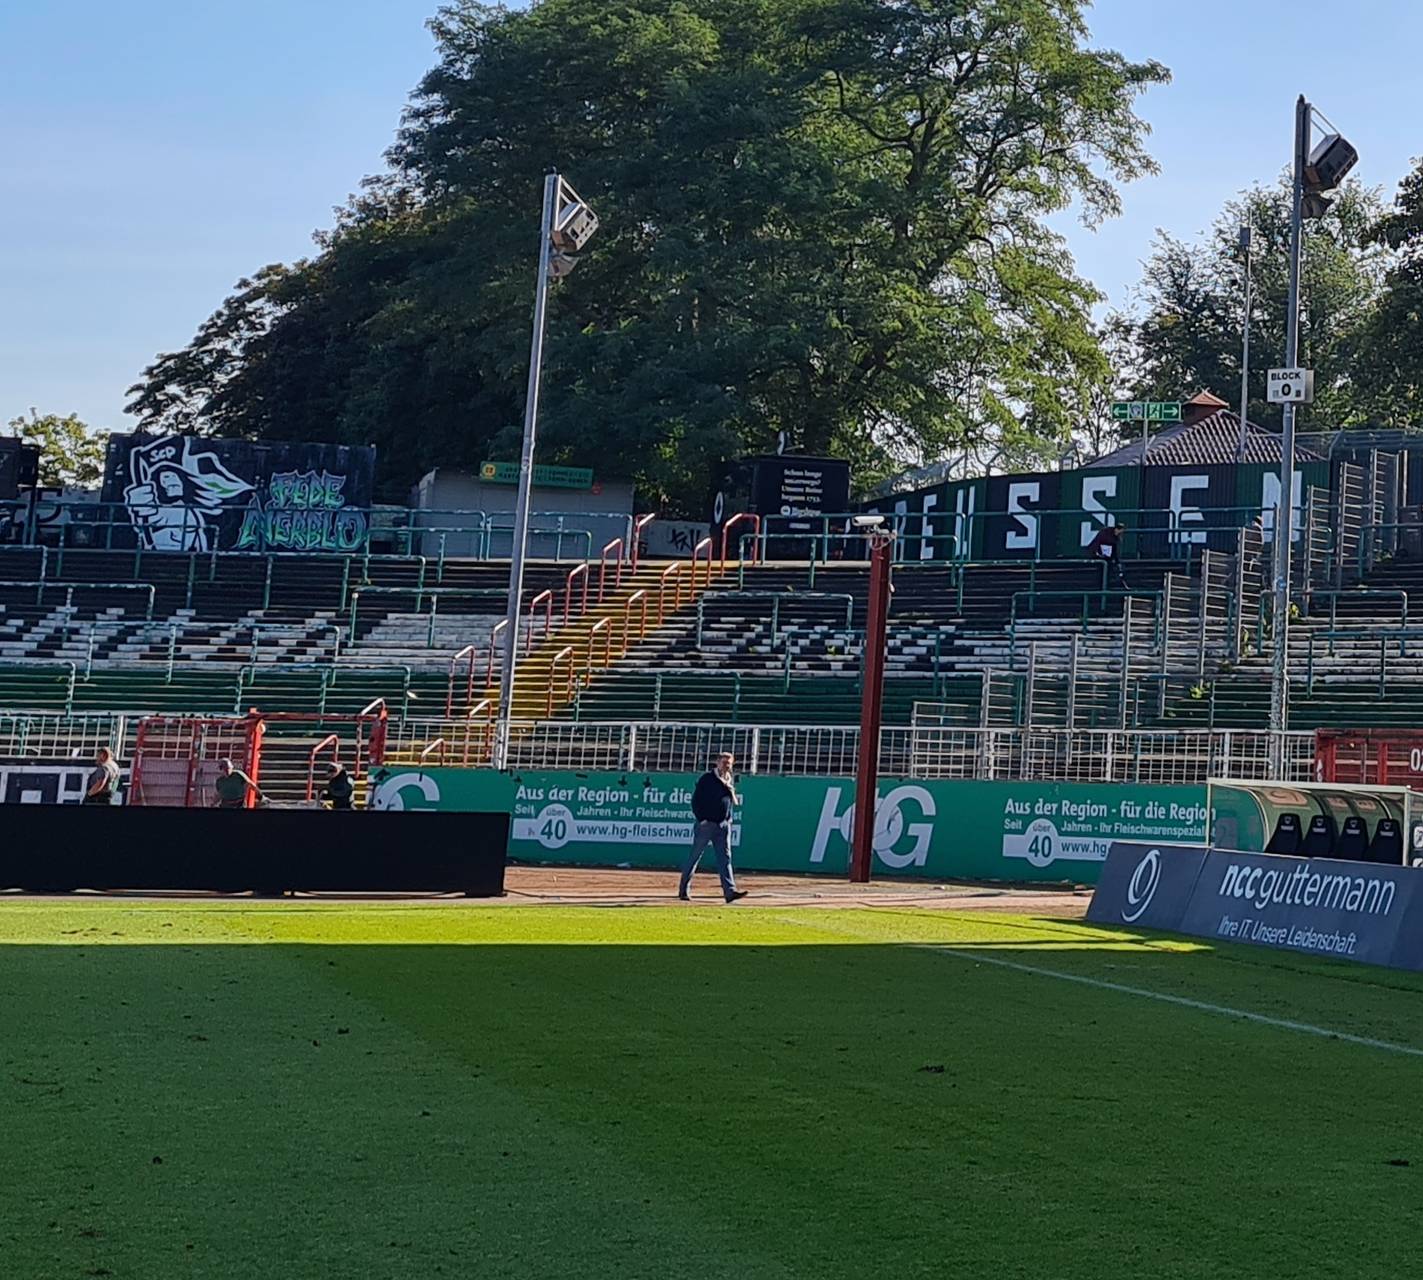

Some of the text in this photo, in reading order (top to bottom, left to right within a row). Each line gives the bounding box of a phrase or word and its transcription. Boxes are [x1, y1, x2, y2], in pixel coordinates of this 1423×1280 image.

[1271, 371, 1302, 381] BLOCK
[150, 446, 176, 461] SCP
[515, 785, 544, 800] Aus
[550, 786, 573, 801] der
[578, 787, 629, 804] Region
[643, 786, 668, 803] für
[669, 788, 692, 804] die
[1004, 799, 1031, 815] Aus
[1035, 799, 1058, 816] der
[1061, 800, 1108, 822] Region
[1120, 801, 1142, 818] für
[1145, 801, 1166, 819] die
[540, 819, 567, 840] 40
[577, 806, 611, 817] Jahren
[620, 807, 634, 818] Ihr
[1004, 818, 1022, 830] Seit
[1032, 823, 1051, 832] über
[1061, 820, 1092, 832] Jahren
[1100, 822, 1112, 833] Ihr
[1114, 822, 1216, 838] Fleischwarenspezialt
[1028, 835, 1052, 858] 40
[1061, 840, 1107, 857] www.hg
[1218, 915, 1357, 954] Ihre IT. Unsere Leidenschaft.
